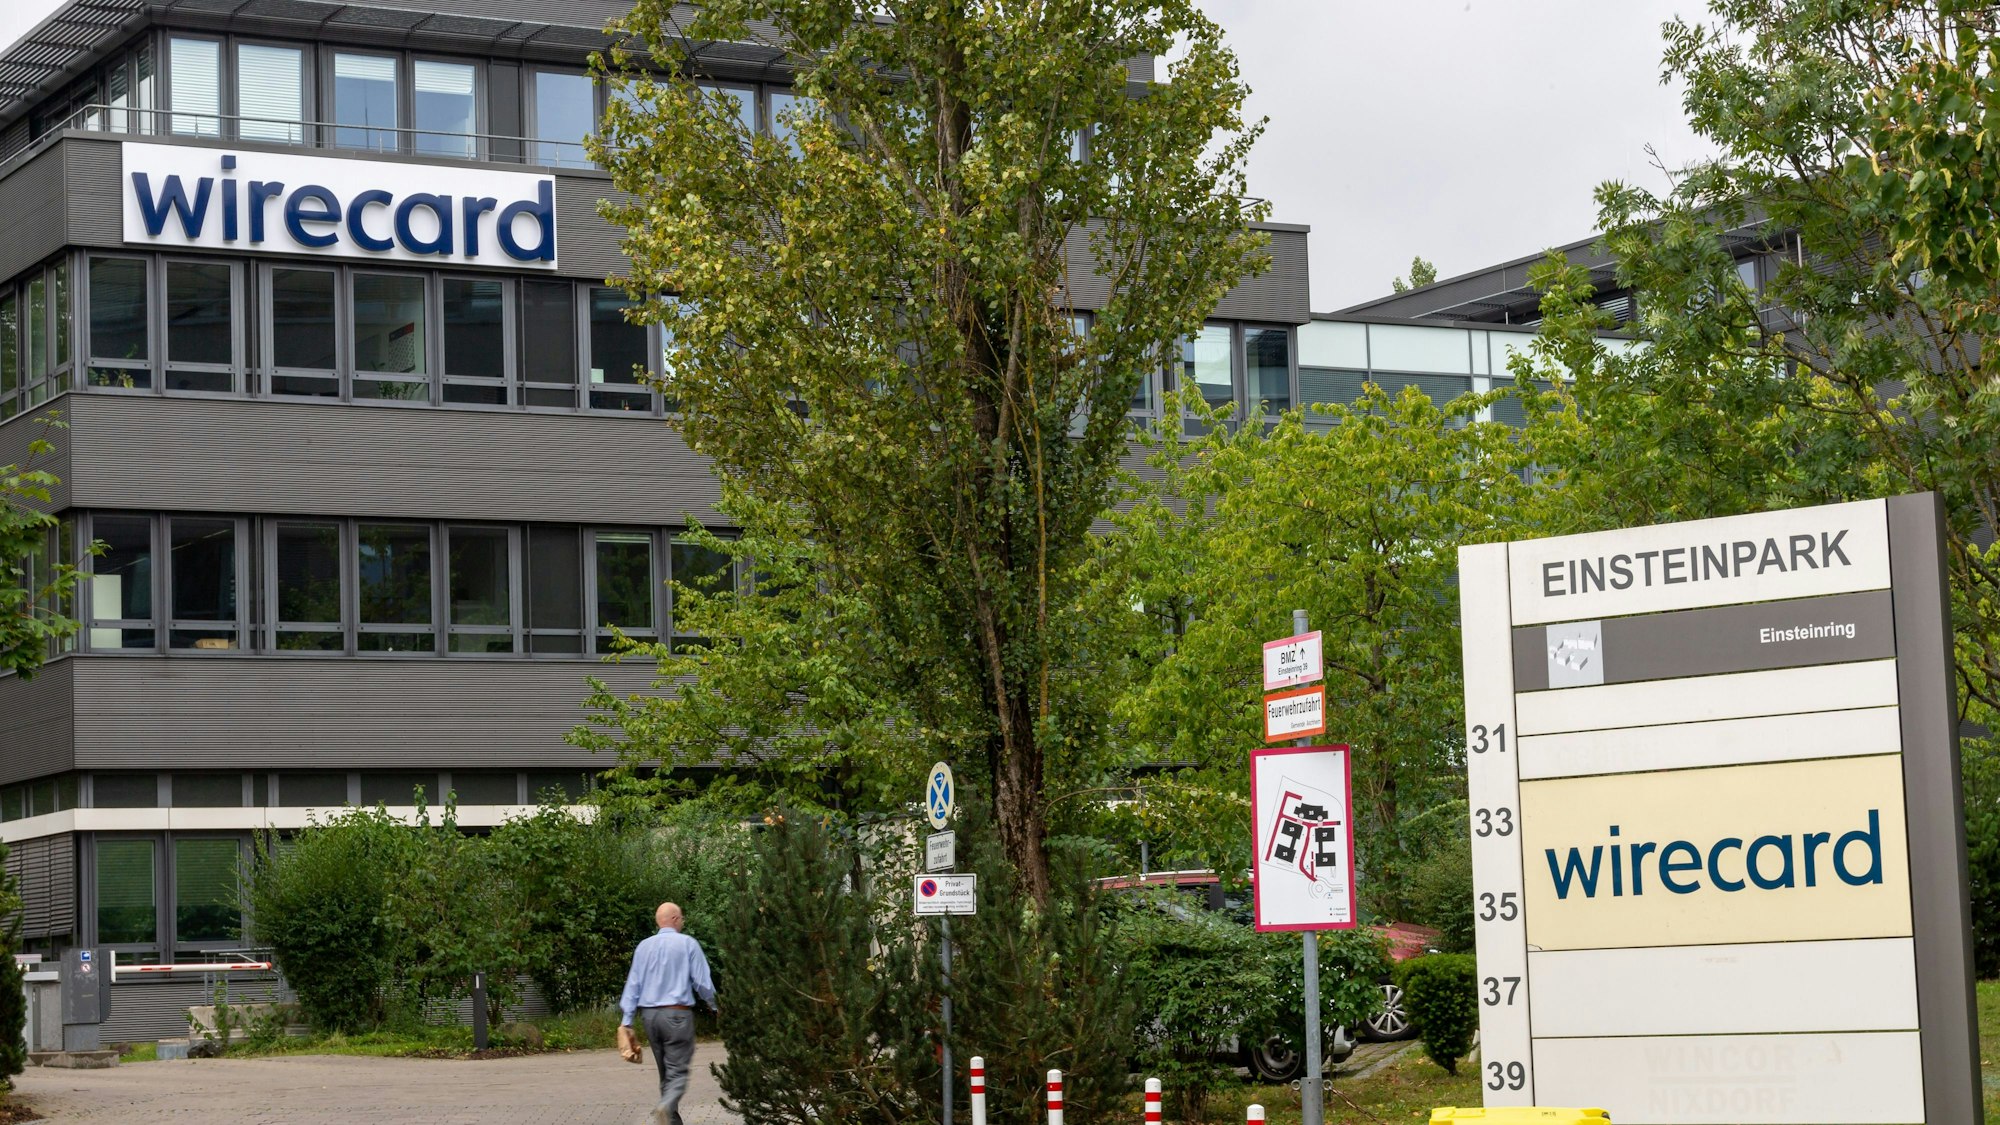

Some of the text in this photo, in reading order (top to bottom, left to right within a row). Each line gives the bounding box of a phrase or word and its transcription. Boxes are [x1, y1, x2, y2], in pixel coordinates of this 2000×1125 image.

[131, 155, 556, 262] wirecard
[1543, 529, 1851, 597] EINSTEINPARK
[1760, 621, 1856, 644] Einsteinring
[1281, 650, 1296, 664] BMZ
[1268, 696, 1321, 719] Feuerwehrzufahrt
[1471, 724, 1507, 755] 31
[1475, 808, 1514, 837] 33
[1545, 809, 1882, 899] wirecard
[939, 889, 970, 897] Grundstück
[1479, 892, 1518, 922] 35
[1483, 976, 1522, 1006] 37
[1644, 1045, 1796, 1073] WINCOR
[1487, 1061, 1526, 1091] 39
[1648, 1087, 1797, 1114] NIXDORF
